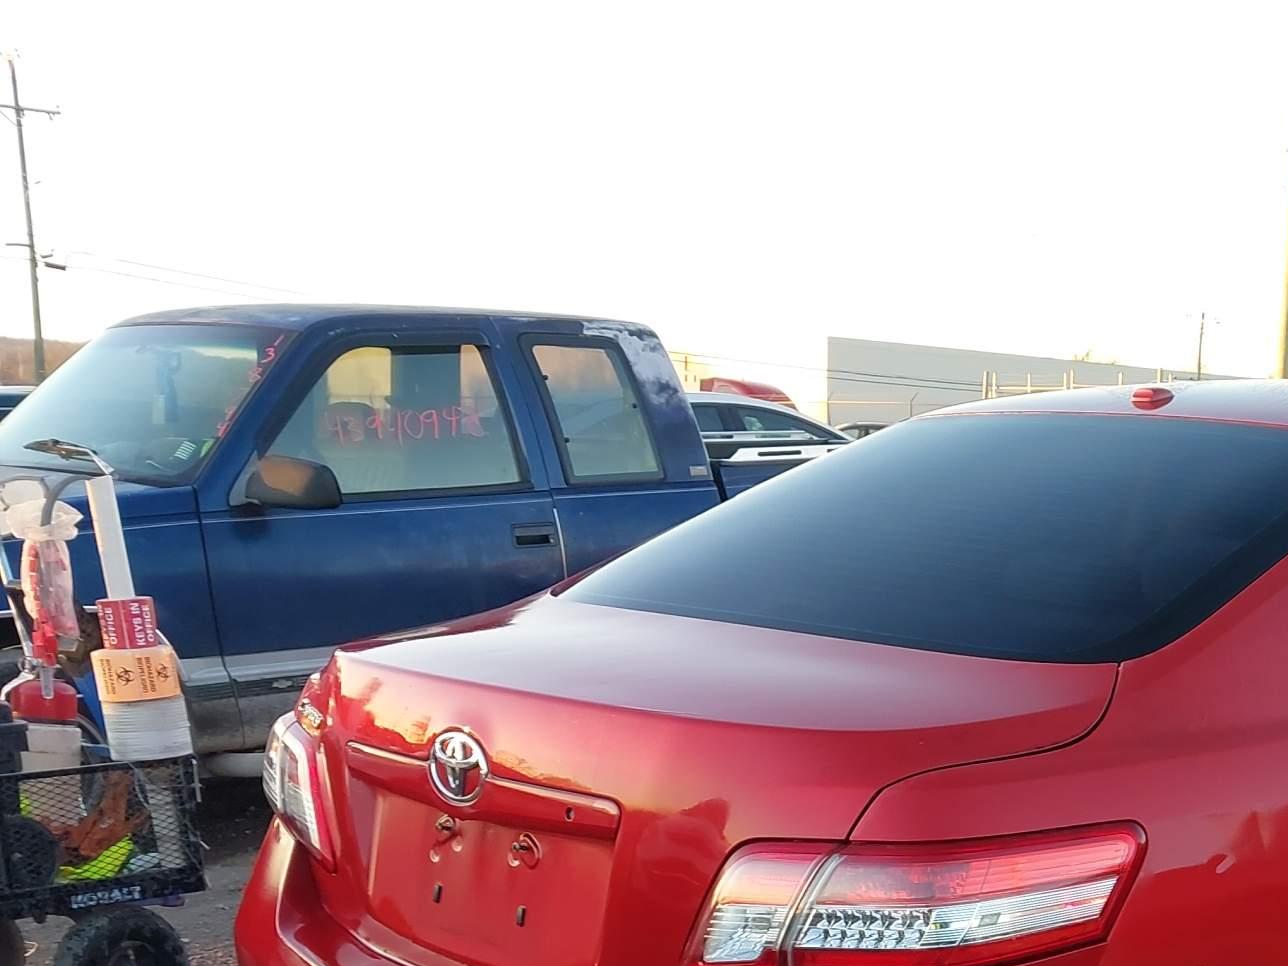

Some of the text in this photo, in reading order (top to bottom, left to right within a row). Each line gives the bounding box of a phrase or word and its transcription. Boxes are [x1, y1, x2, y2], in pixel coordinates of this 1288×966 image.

[104, 608, 118, 645] OFFICE
[129, 603, 146, 646] KEYS IN
[142, 605, 155, 642] OFFICE
[71, 886, 141, 909] KOBALT
